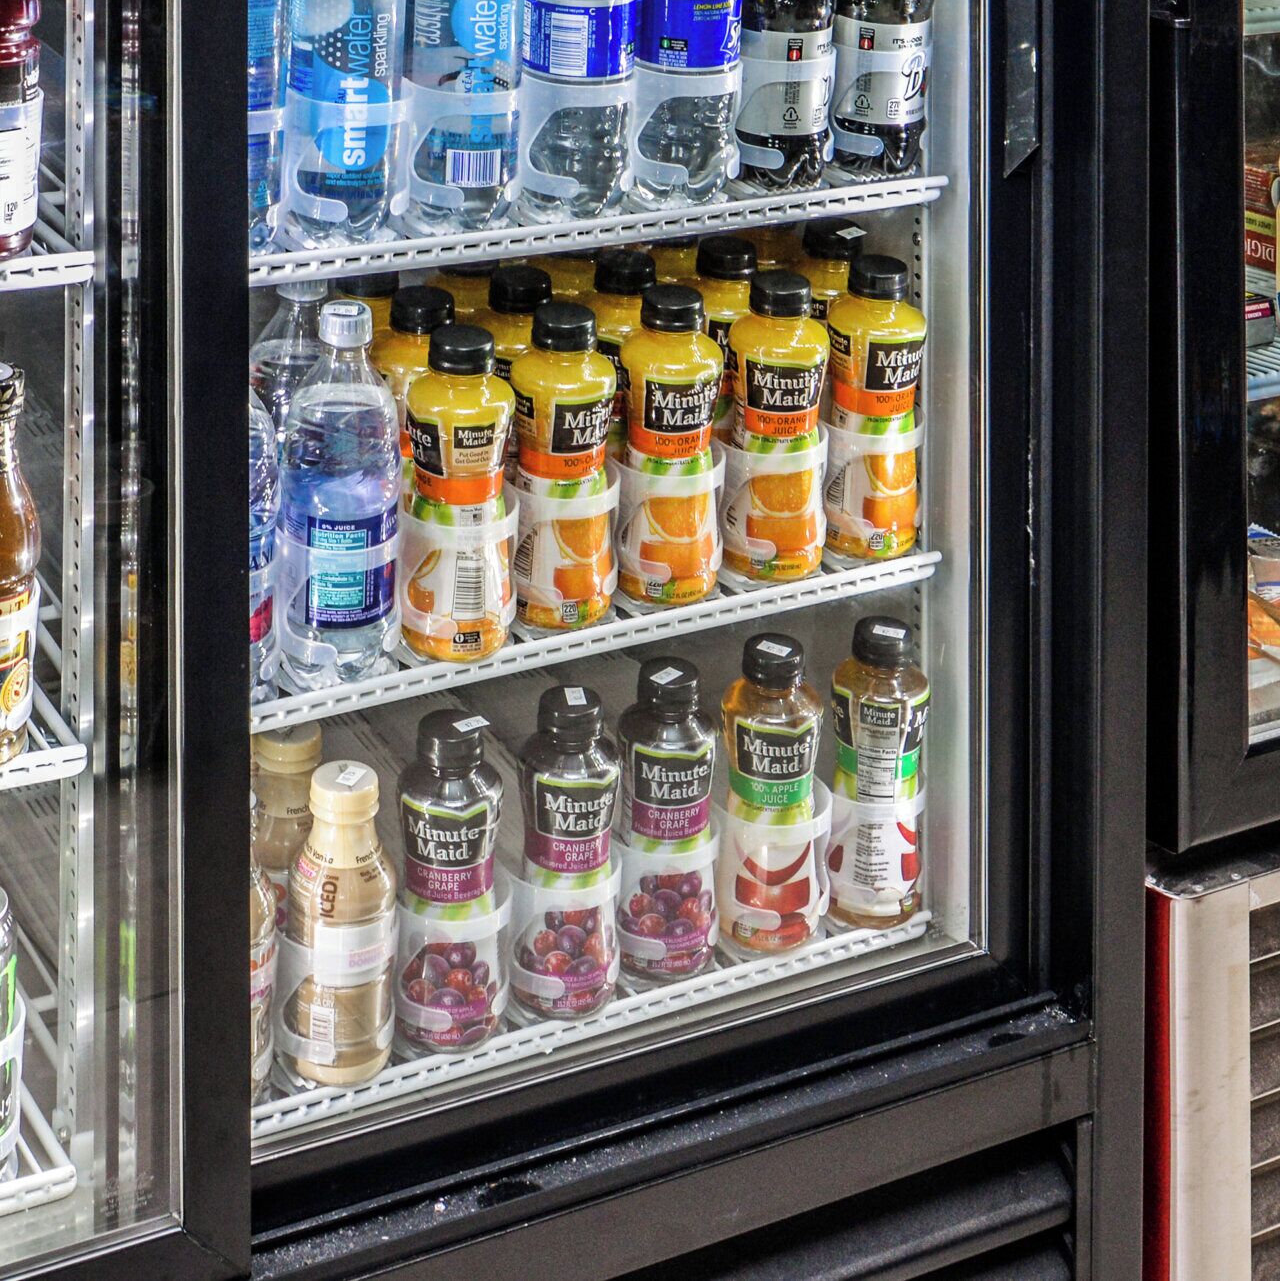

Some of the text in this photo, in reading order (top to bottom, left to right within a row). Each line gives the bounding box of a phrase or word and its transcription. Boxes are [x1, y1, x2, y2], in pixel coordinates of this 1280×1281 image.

[372, 13, 391, 78] sparkling
[342, 11, 371, 166] smartwater
[753, 367, 819, 390] Minute
[756, 414, 775, 425] 100%
[334, 523, 356, 531] JUICE
[563, 604, 577, 614] 220
[862, 706, 896, 719] Minute
[742, 735, 810, 757] Minute
[641, 761, 710, 783] Minute
[752, 754, 803, 774] Maid
[650, 782, 702, 801] Maid
[771, 782, 799, 793] APPLE
[544, 791, 614, 812] Minute
[762, 793, 789, 804] JUICE
[555, 811, 605, 832] Maid
[648, 807, 700, 821] CRANBERRY
[408, 814, 481, 843] Minute
[659, 819, 690, 829] GRAPE
[417, 838, 470, 862] Maid
[417, 867, 473, 882] CRANBERRY
[428, 881, 460, 892] GRAPE
[433, 890, 452, 901] Juice
[320, 882, 338, 919] ICED
